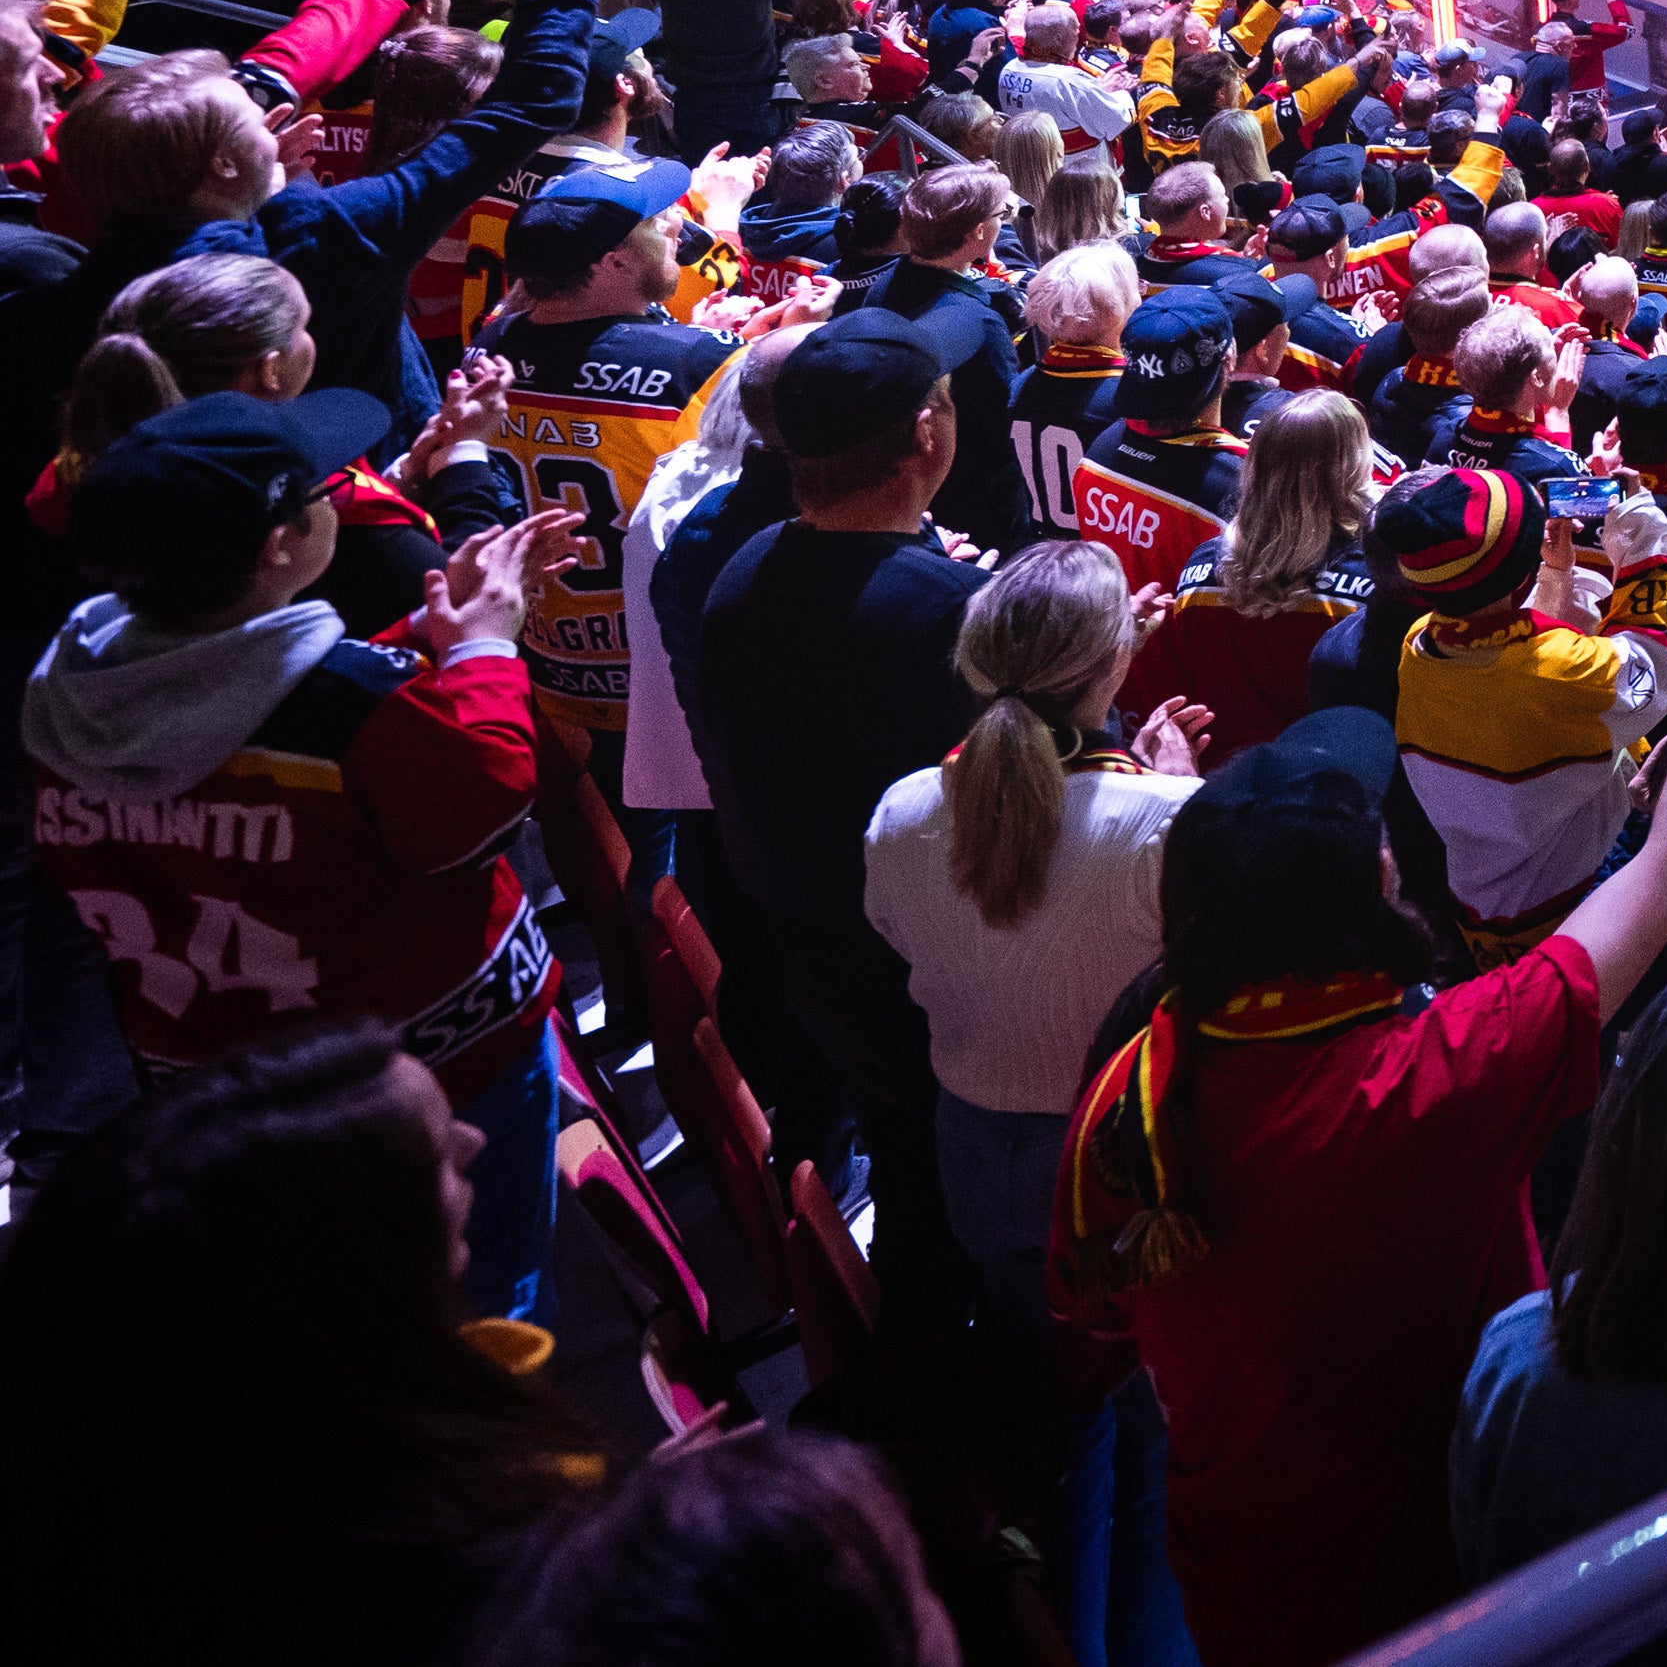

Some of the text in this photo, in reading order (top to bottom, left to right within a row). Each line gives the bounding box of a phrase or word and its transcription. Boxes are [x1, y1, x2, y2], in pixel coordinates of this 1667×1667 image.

[573, 361, 672, 397] SSAB
[500, 414, 601, 448] NAB
[1010, 419, 1084, 530] 10
[1084, 487, 1161, 549] SSAB
[1335, 575, 1375, 598] LKA
[544, 663, 630, 695] SSAB
